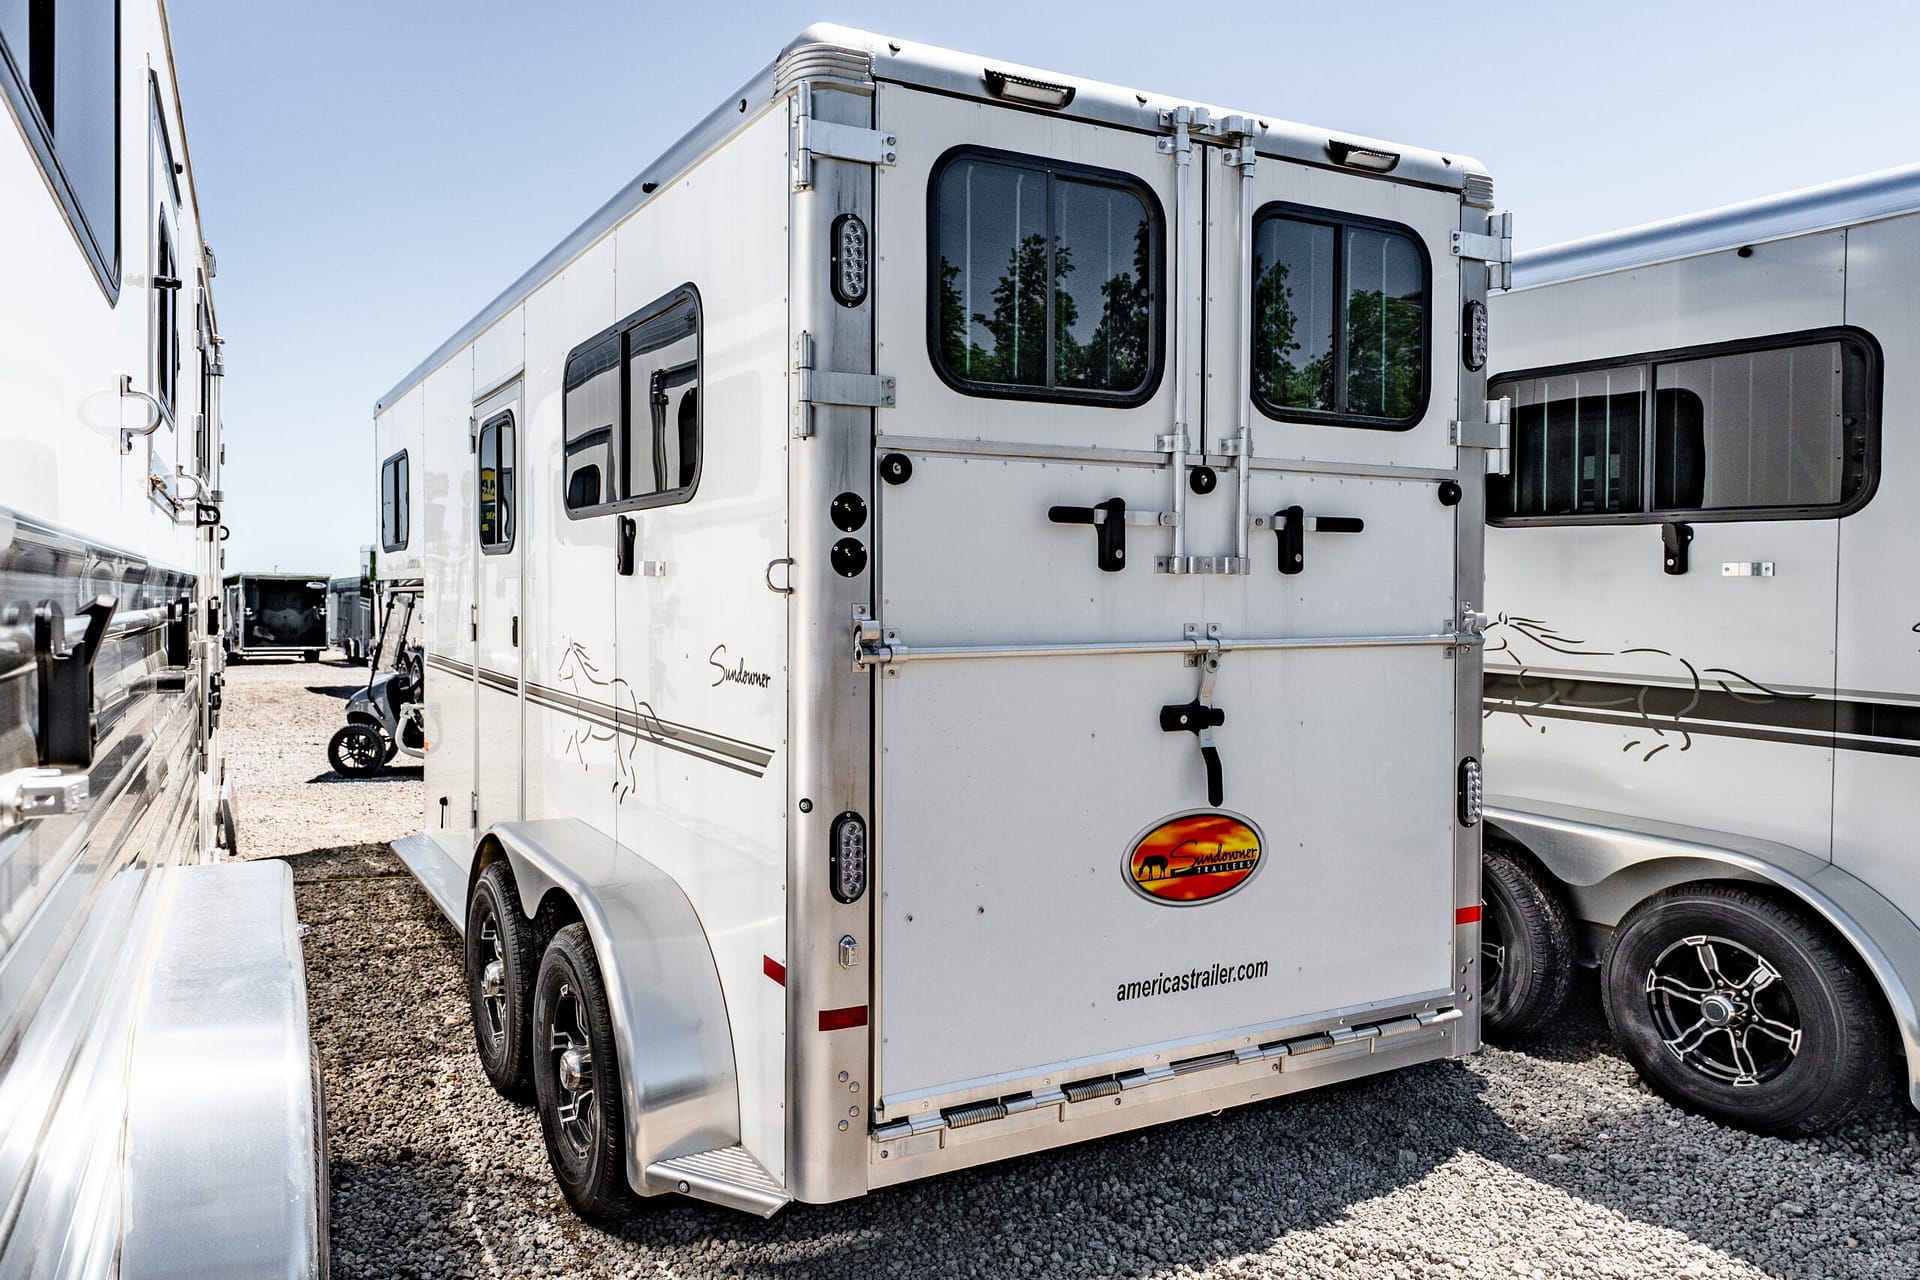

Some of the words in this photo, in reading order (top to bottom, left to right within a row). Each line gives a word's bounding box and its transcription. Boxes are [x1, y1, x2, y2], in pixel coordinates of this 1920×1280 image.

[709, 644, 771, 688] Sundowner
[1170, 839, 1258, 871] Sundowner
[1197, 861, 1252, 874] TRAILERS
[1117, 960, 1268, 1002] americastrailer.com
